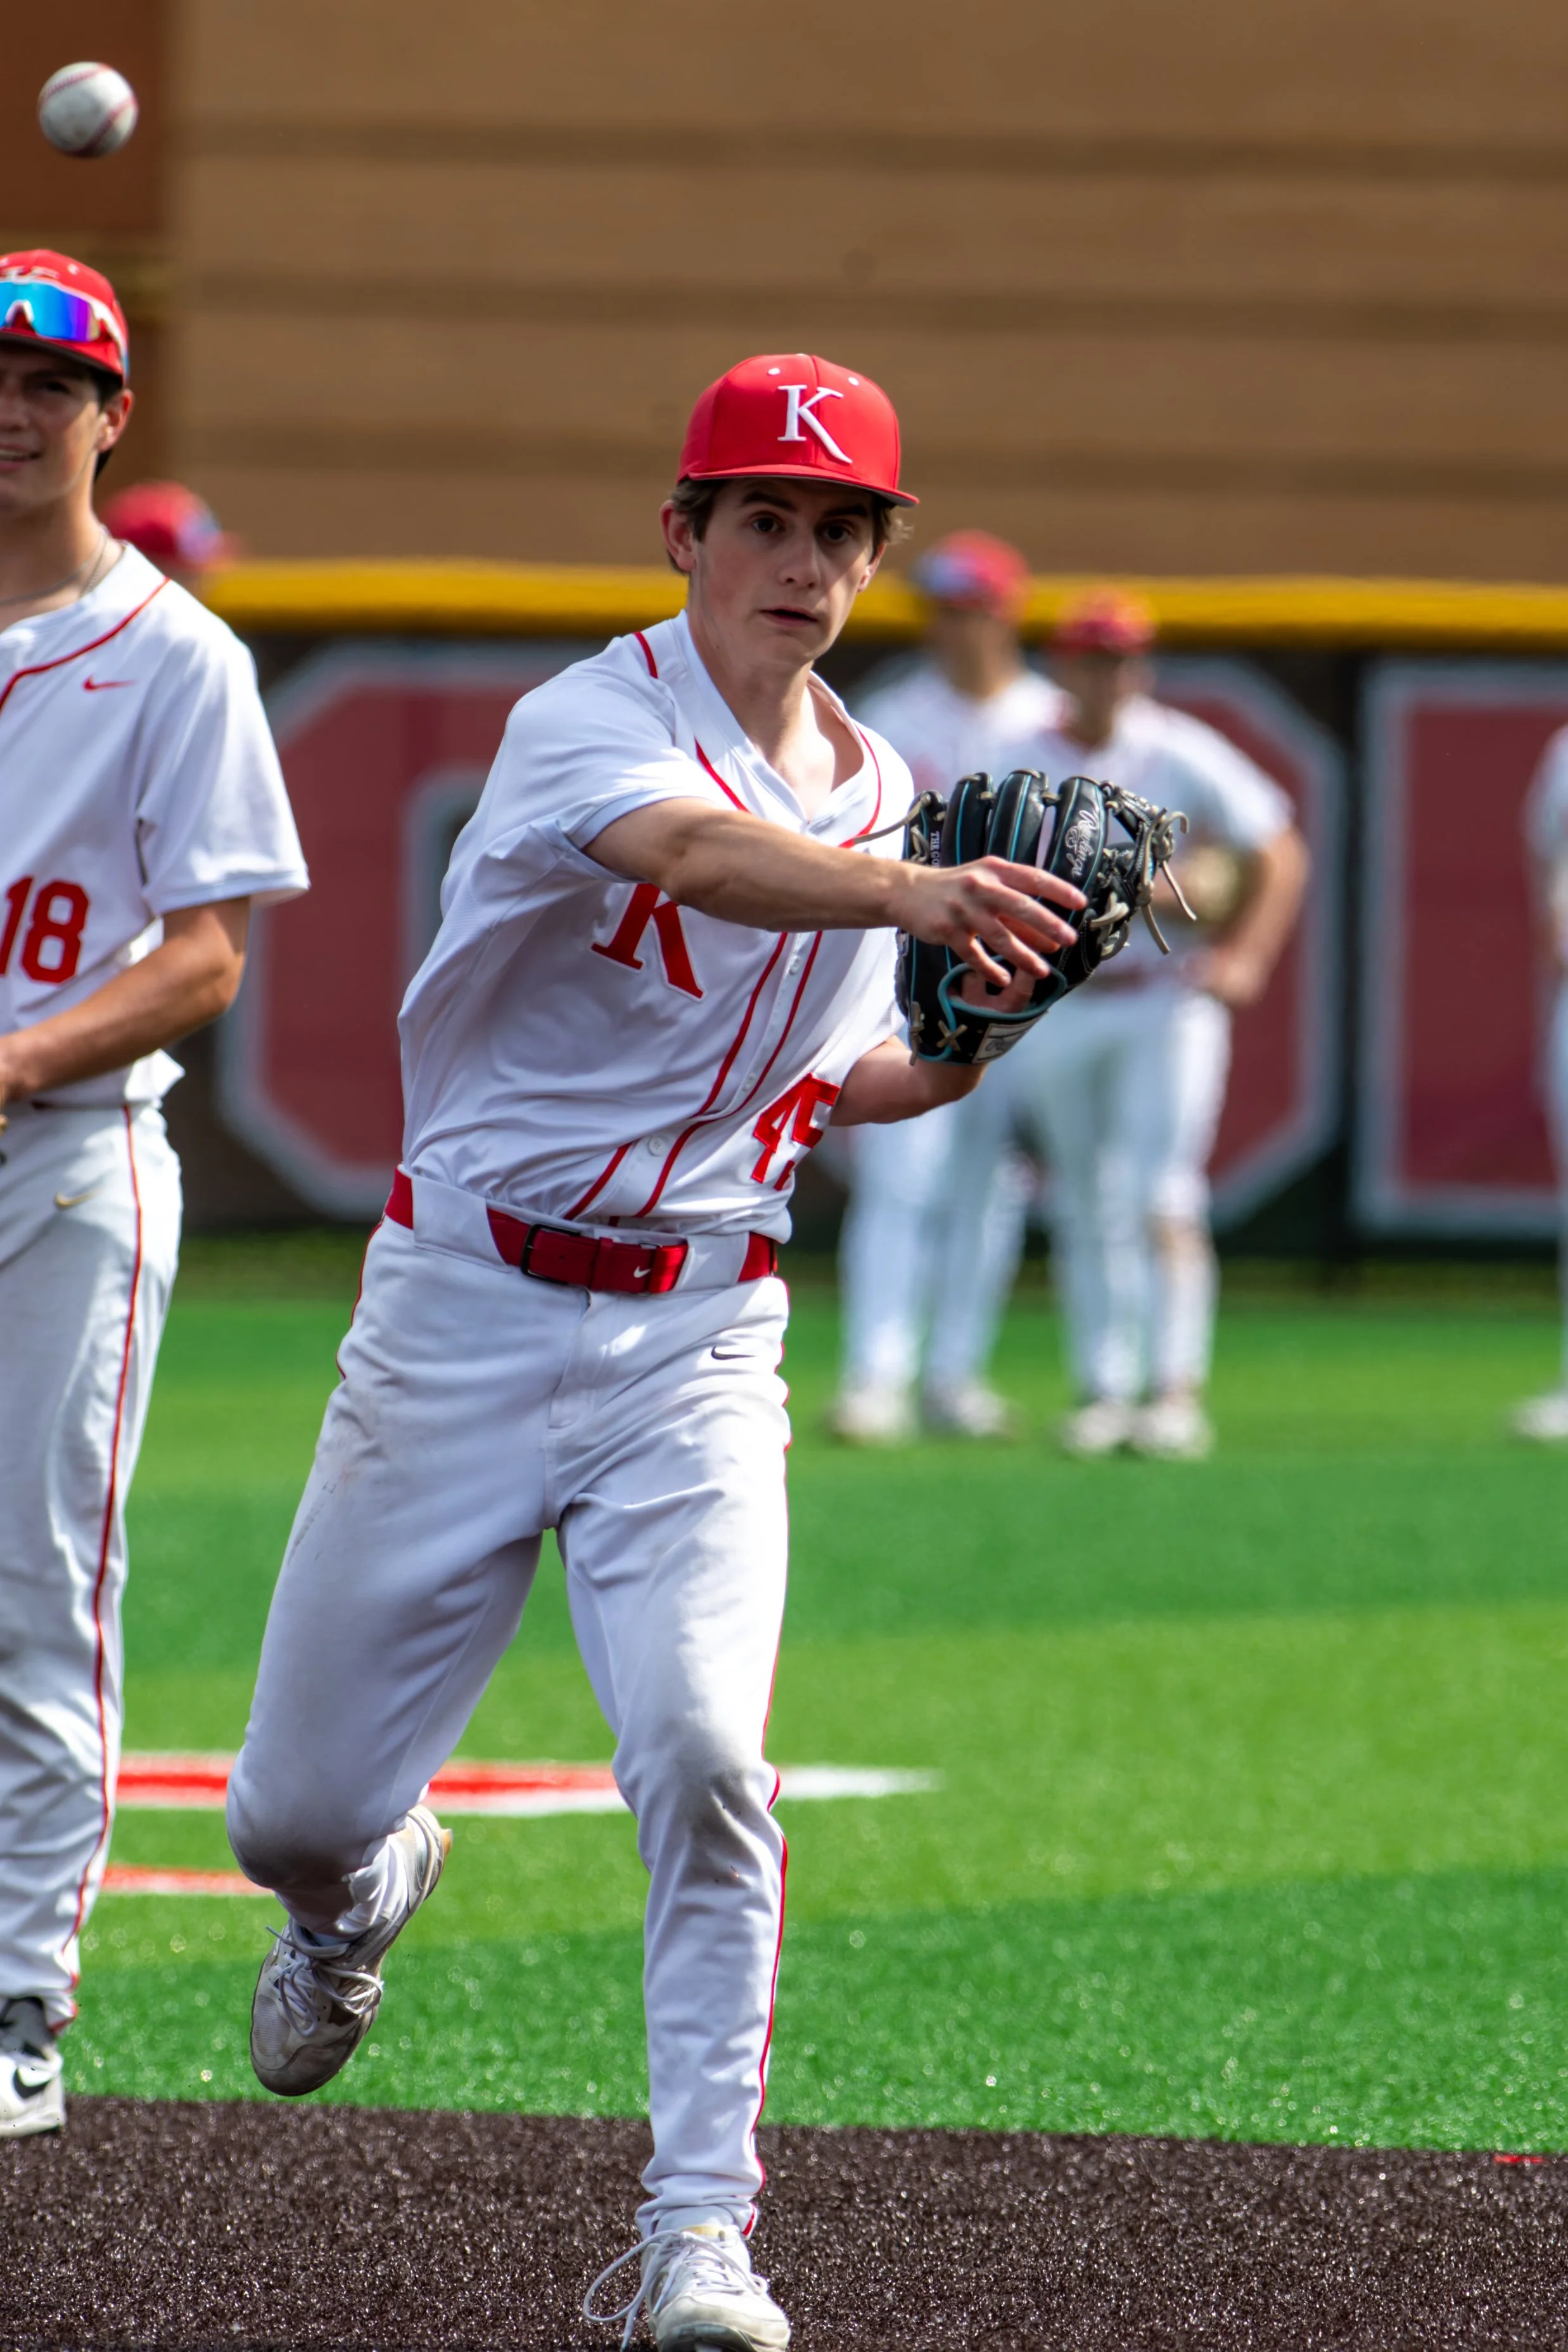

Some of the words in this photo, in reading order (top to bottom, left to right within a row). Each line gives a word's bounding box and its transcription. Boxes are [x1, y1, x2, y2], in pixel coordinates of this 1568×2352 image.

[777, 384, 853, 464] K
[930, 831, 940, 850] THE
[1066, 809, 1099, 878] Rawlings
[0, 876, 89, 985] 18
[590, 882, 706, 1001] K
[751, 1072, 841, 1191] 45
